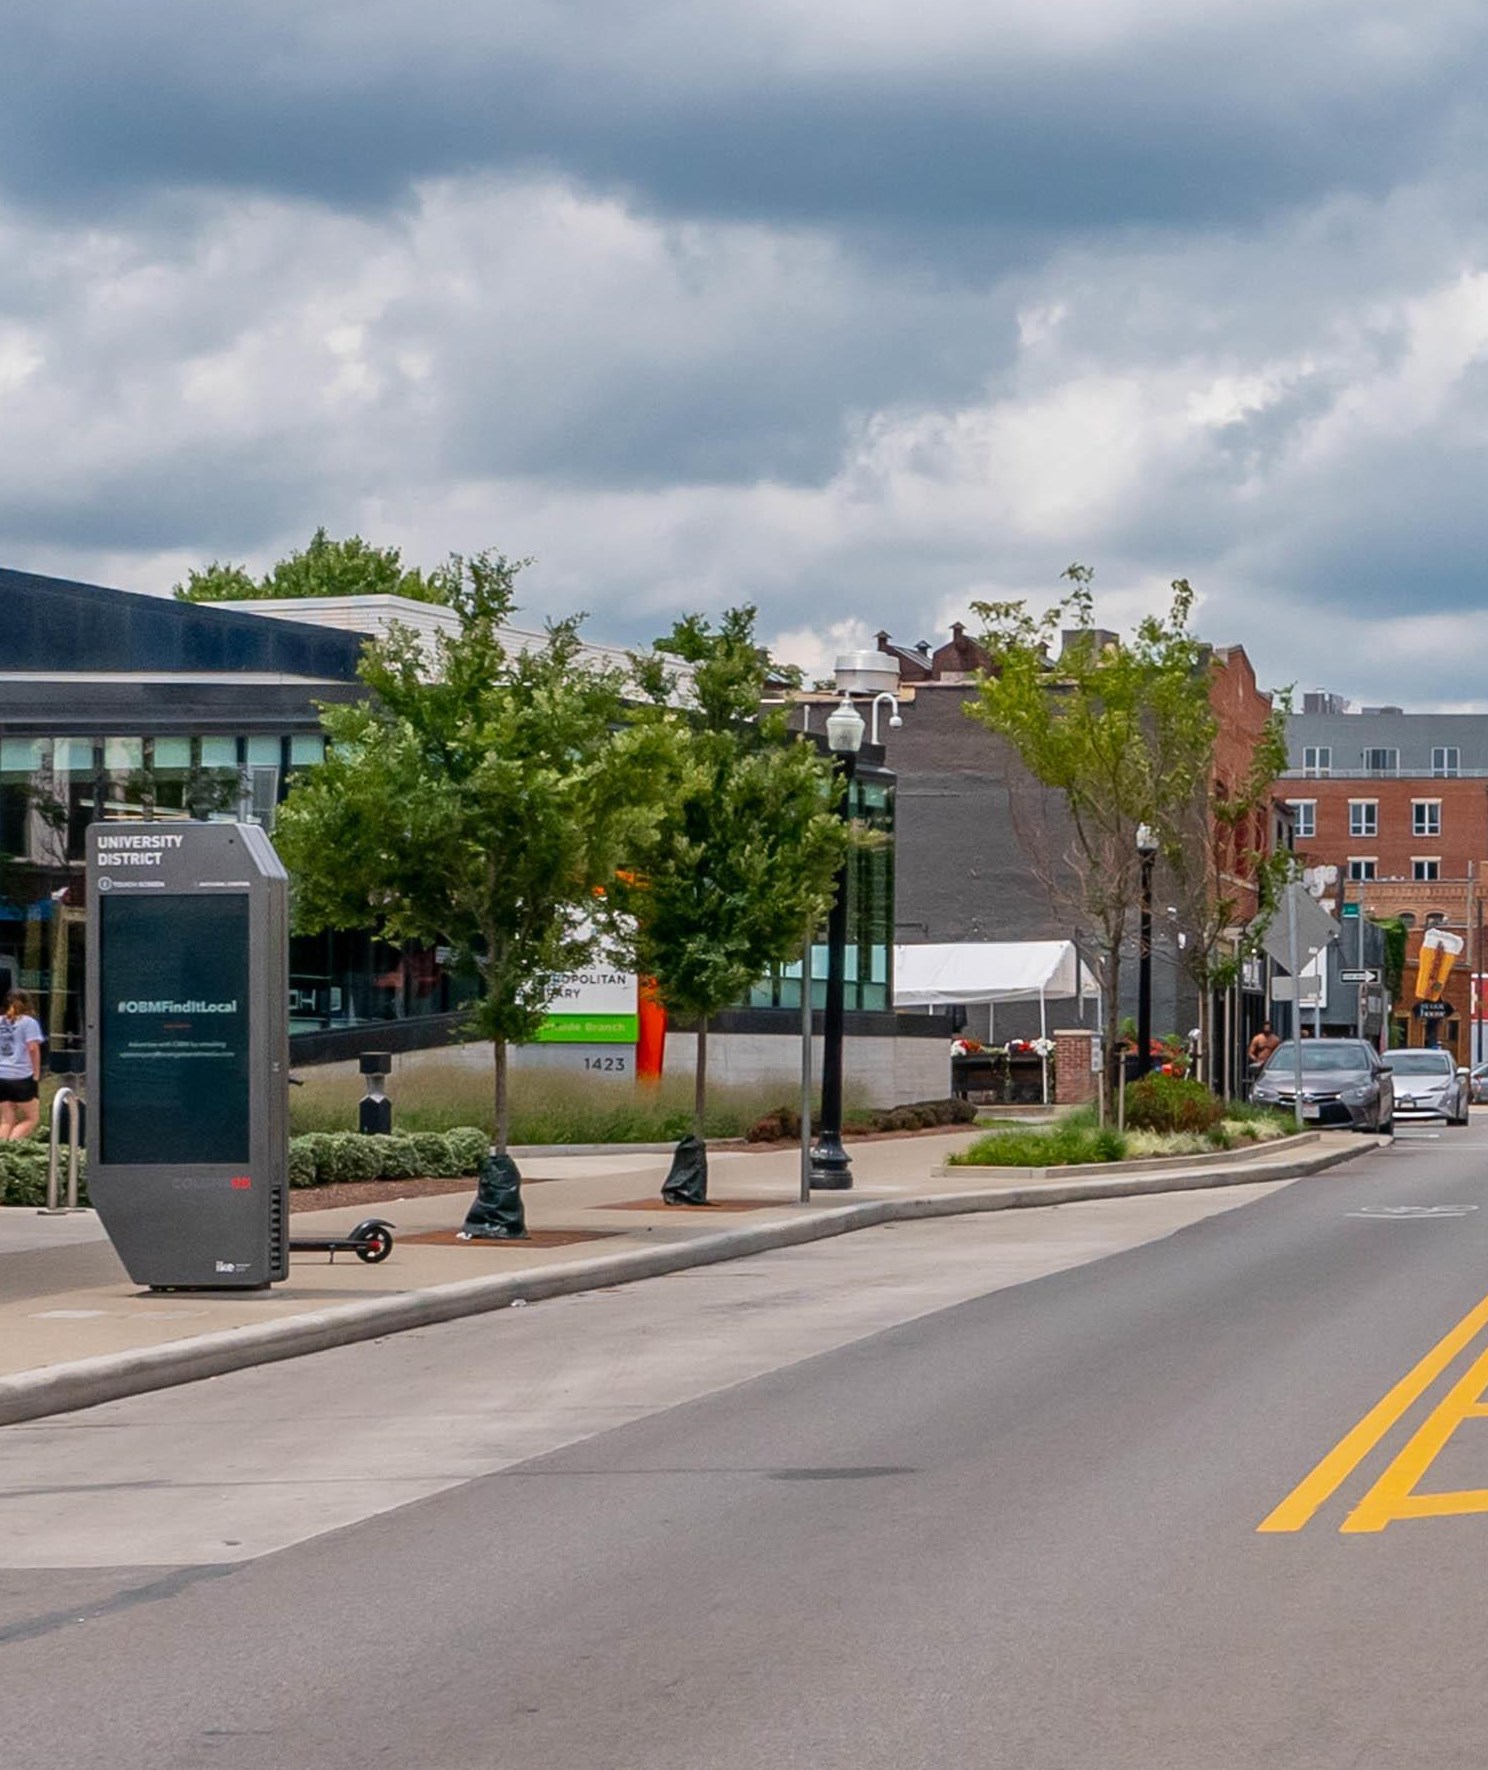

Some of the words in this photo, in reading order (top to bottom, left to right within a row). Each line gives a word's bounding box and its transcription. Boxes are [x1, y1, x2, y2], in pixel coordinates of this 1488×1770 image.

[97, 834, 184, 849] UNIVERSITY
[97, 851, 163, 866] DISTRICT
[118, 1000, 237, 1013] #OBMFindItLocal
[584, 1057, 625, 1071] 1423
